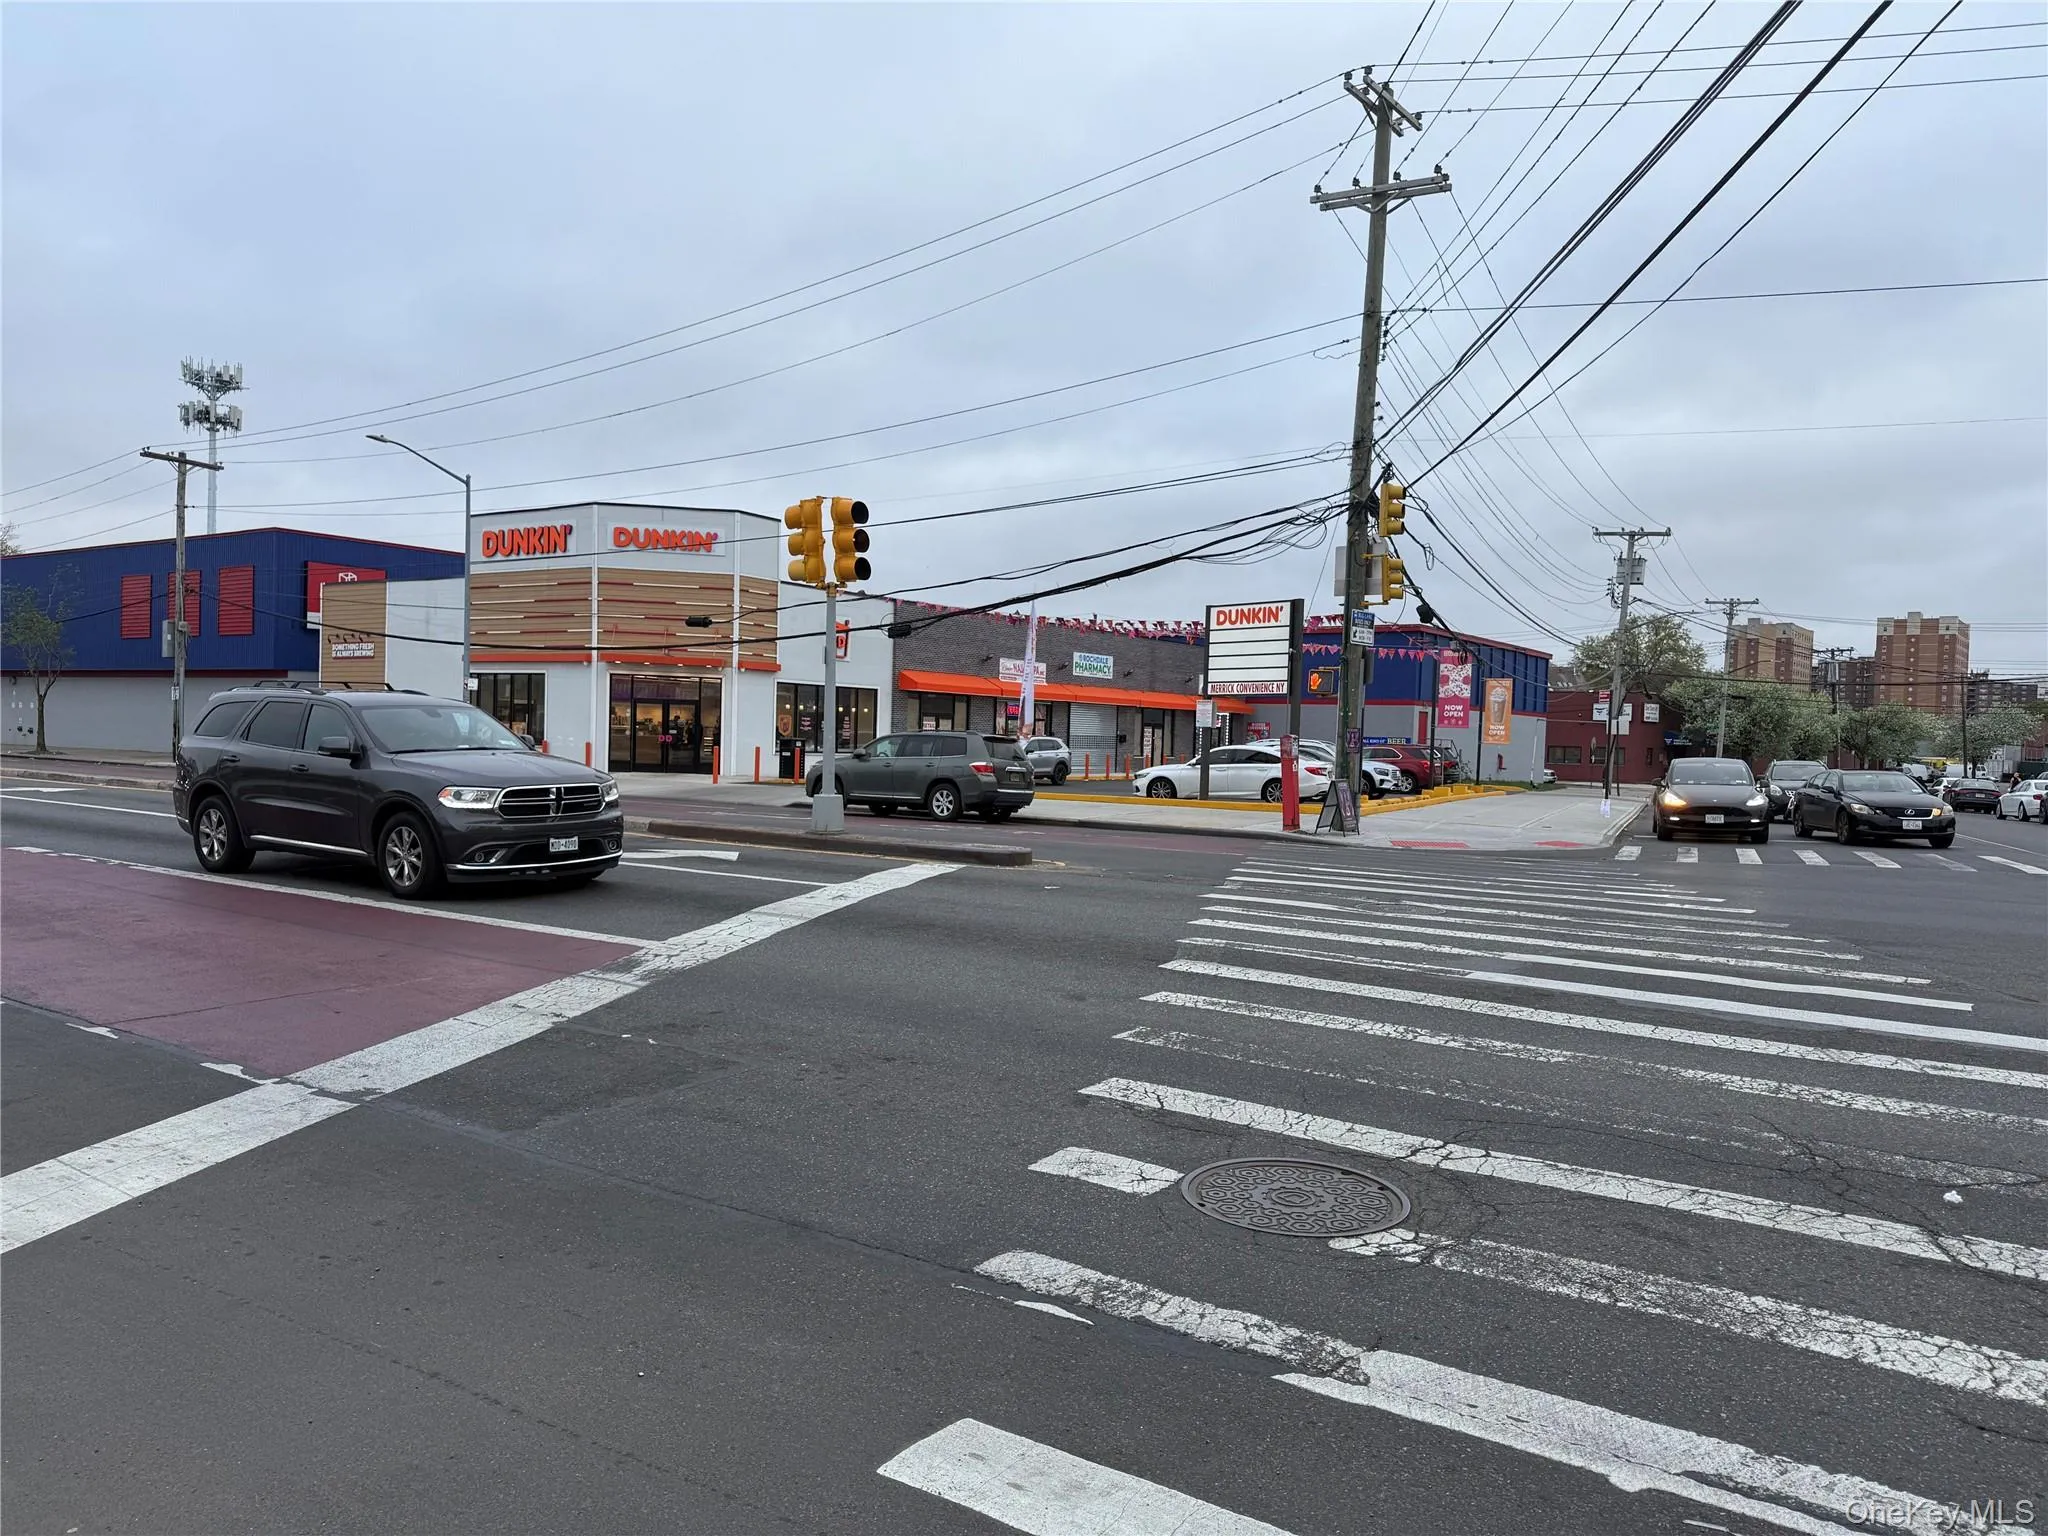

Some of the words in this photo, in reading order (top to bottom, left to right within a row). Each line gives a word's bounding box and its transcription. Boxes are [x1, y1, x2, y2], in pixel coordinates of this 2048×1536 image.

[482, 524, 572, 558] DUNKIN'
[613, 526, 719, 552] DUNKIN'
[1216, 605, 1284, 626] DUNKIN'
[1075, 661, 1111, 675] PHARMACY
[1210, 684, 1235, 694] MERRICK
[1236, 683, 1275, 693] CONVENIENCE
[1276, 682, 1285, 693] NY
